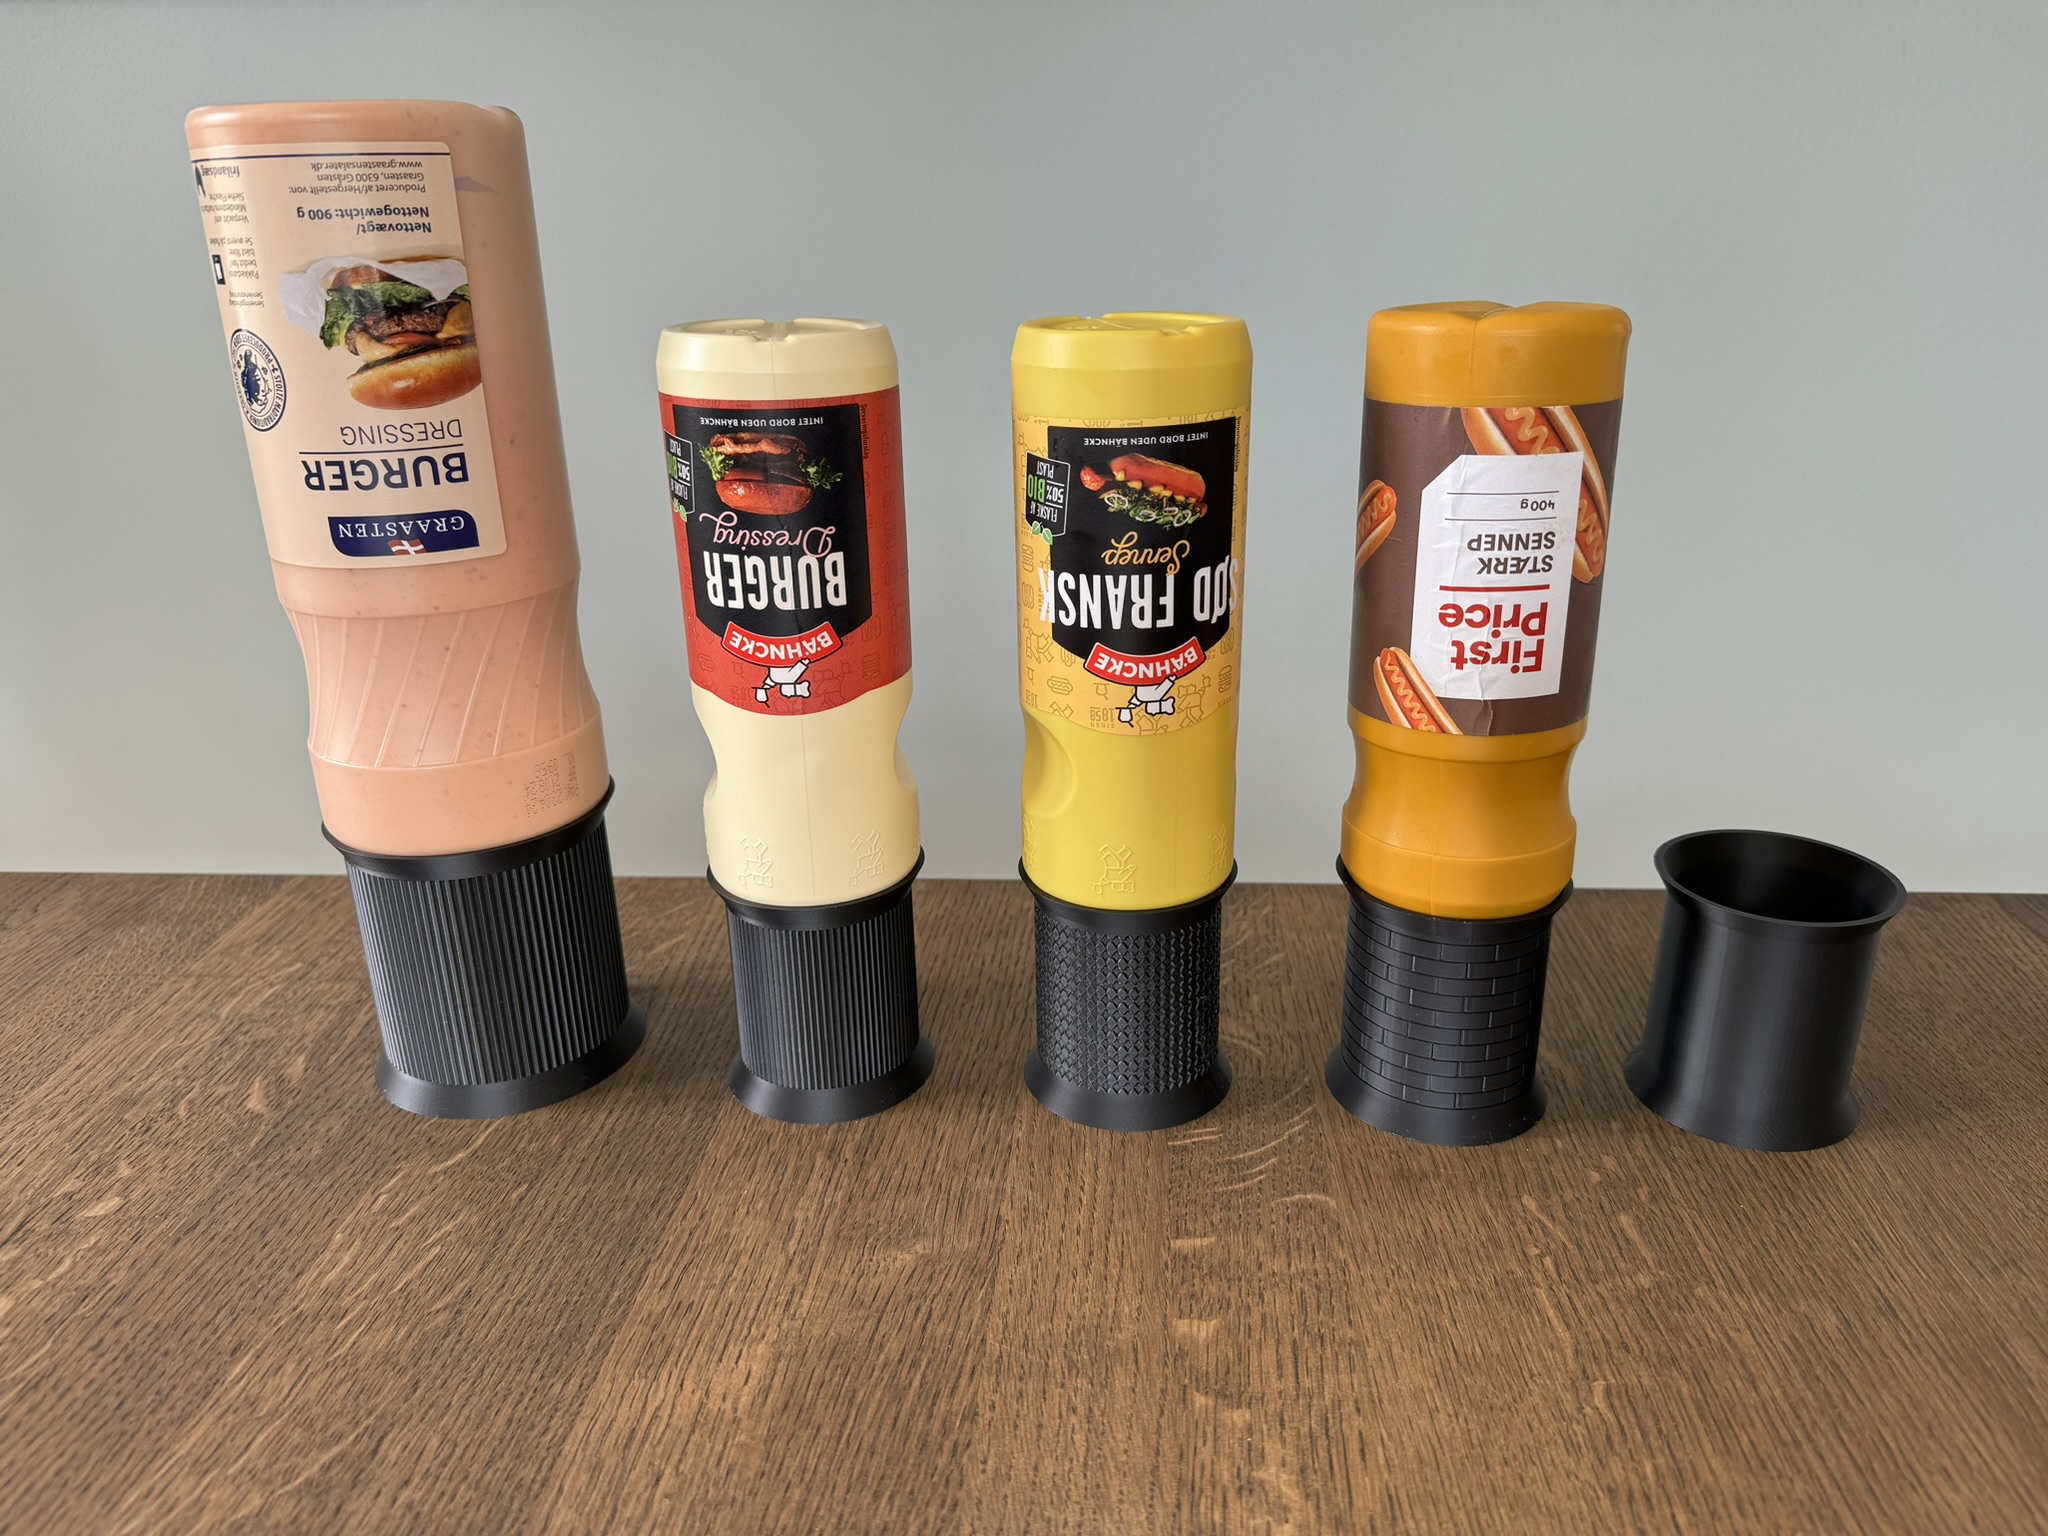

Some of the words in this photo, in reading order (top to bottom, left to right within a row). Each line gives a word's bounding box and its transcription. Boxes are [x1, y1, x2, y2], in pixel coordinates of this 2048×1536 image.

[201, 165, 240, 178] frilandsæg
[310, 160, 423, 172] www.graastensalater.dk
[317, 173, 354, 183] Gråsten
[356, 173, 380, 182] 6300
[380, 172, 424, 182] Graasten,
[289, 186, 309, 194] von:
[310, 181, 373, 194] af/Hergestellt
[375, 183, 426, 193] Produceret
[297, 207, 305, 219] g
[308, 209, 333, 220] 900
[335, 204, 429, 220] Nettogewicht:
[356, 220, 432, 235] Nettovægt/
[274, 375, 285, 402] STOLTE
[699, 416, 739, 428] BÄHNCKE
[741, 418, 767, 427] UDEN
[769, 417, 796, 427] BORD
[798, 417, 824, 426] INTET
[339, 418, 463, 446] DRESSING
[1158, 433, 1185, 444] BORD
[1186, 431, 1209, 441] INTET
[1083, 437, 1128, 450] BÄHNCKE
[1130, 436, 1157, 446] UDEN
[300, 452, 470, 491] BURGER
[677, 462, 690, 480] 50%
[1035, 460, 1054, 479] PLAST
[1027, 473, 1046, 503] BIO
[1046, 484, 1065, 503] 50%
[1029, 500, 1036, 515] AF
[1520, 498, 1530, 511] g
[1531, 499, 1555, 512] 400
[1036, 503, 1058, 523] FLASKE
[337, 515, 465, 539] GRAASTEN
[699, 510, 836, 558] Dressing
[1467, 531, 1556, 552] SENNEP
[1100, 531, 1190, 577] Sennep
[1476, 554, 1554, 575] STÆRK
[703, 550, 848, 611] BURGER
[1193, 554, 1240, 625] SØD
[1038, 567, 1175, 630] FRANSK
[1438, 601, 1549, 638] Price
[729, 630, 834, 660] BÄHNCKE
[1094, 645, 1199, 679] BÄHNCKE
[1450, 638, 1544, 674] First
[1089, 707, 1115, 722] 1858
